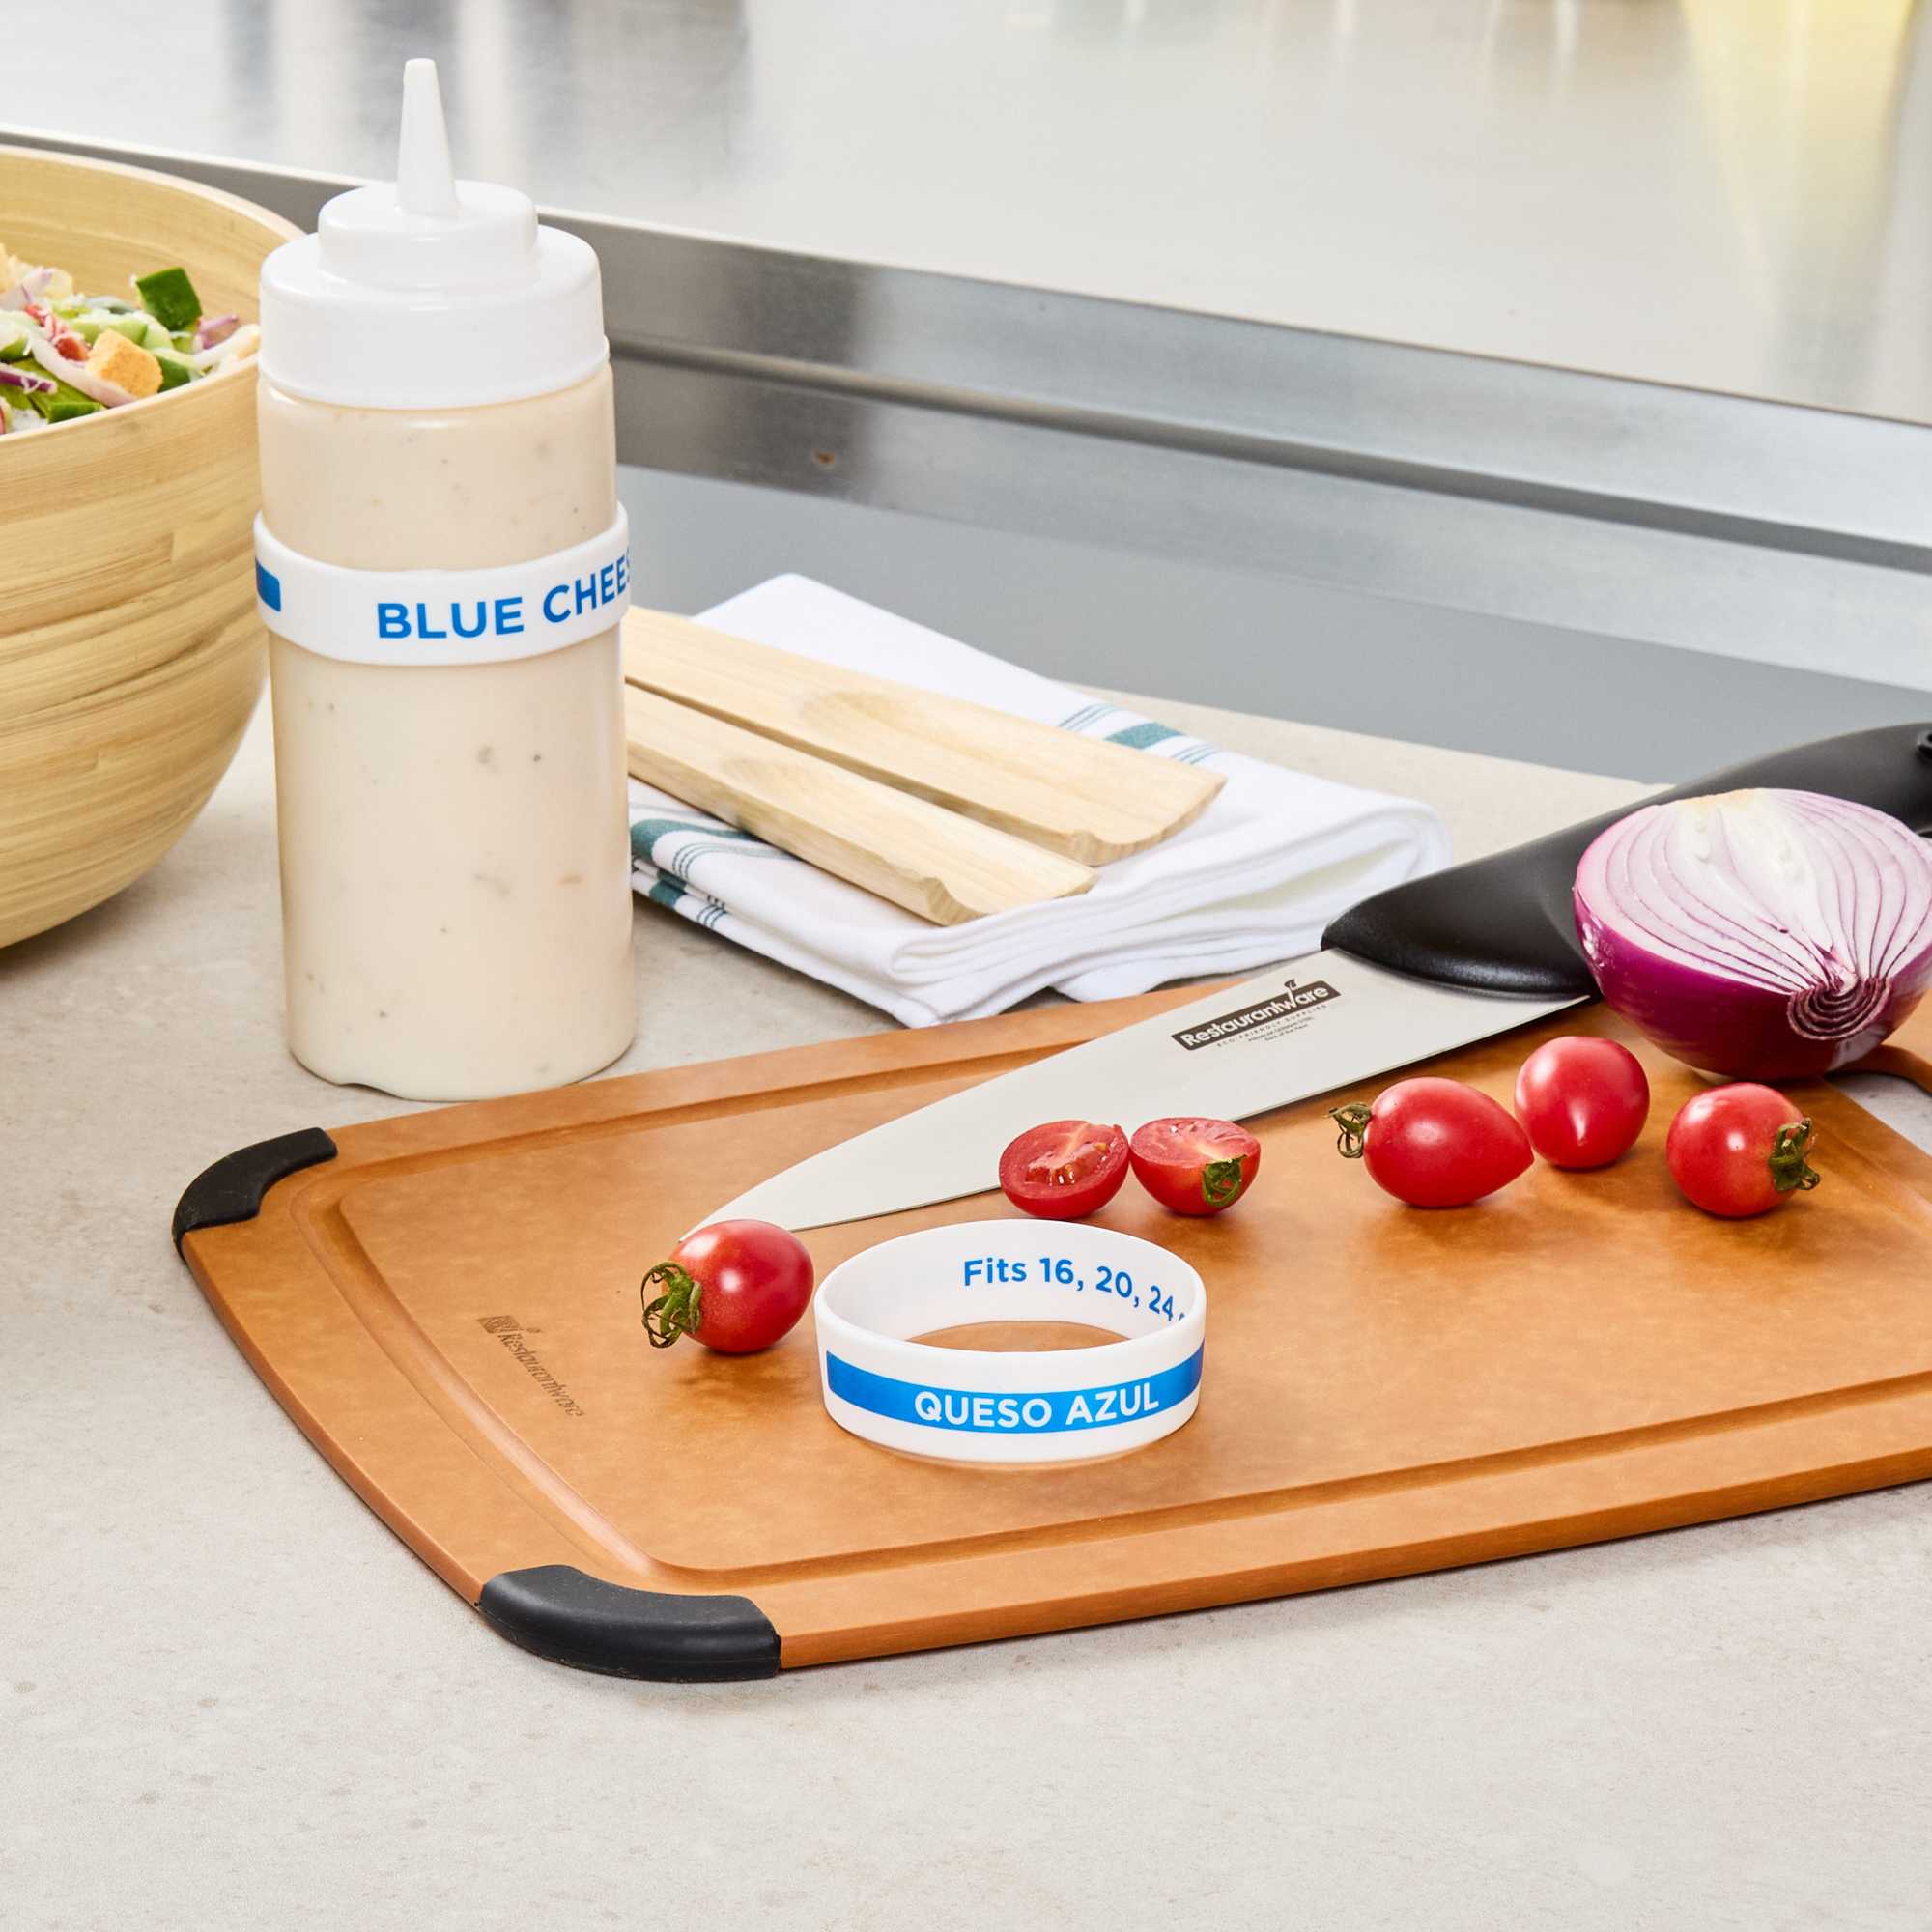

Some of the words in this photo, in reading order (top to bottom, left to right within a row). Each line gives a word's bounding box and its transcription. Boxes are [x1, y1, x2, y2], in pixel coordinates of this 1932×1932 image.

[378, 597, 524, 639] BLUE
[1179, 982, 1330, 1047] Restaurantware
[964, 1257, 1027, 1287] Fits
[1039, 1257, 1085, 1292] 16,
[1095, 1265, 1140, 1308] 20,
[914, 1391, 1052, 1429] QUESO
[1065, 1382, 1159, 1426] AZUL
